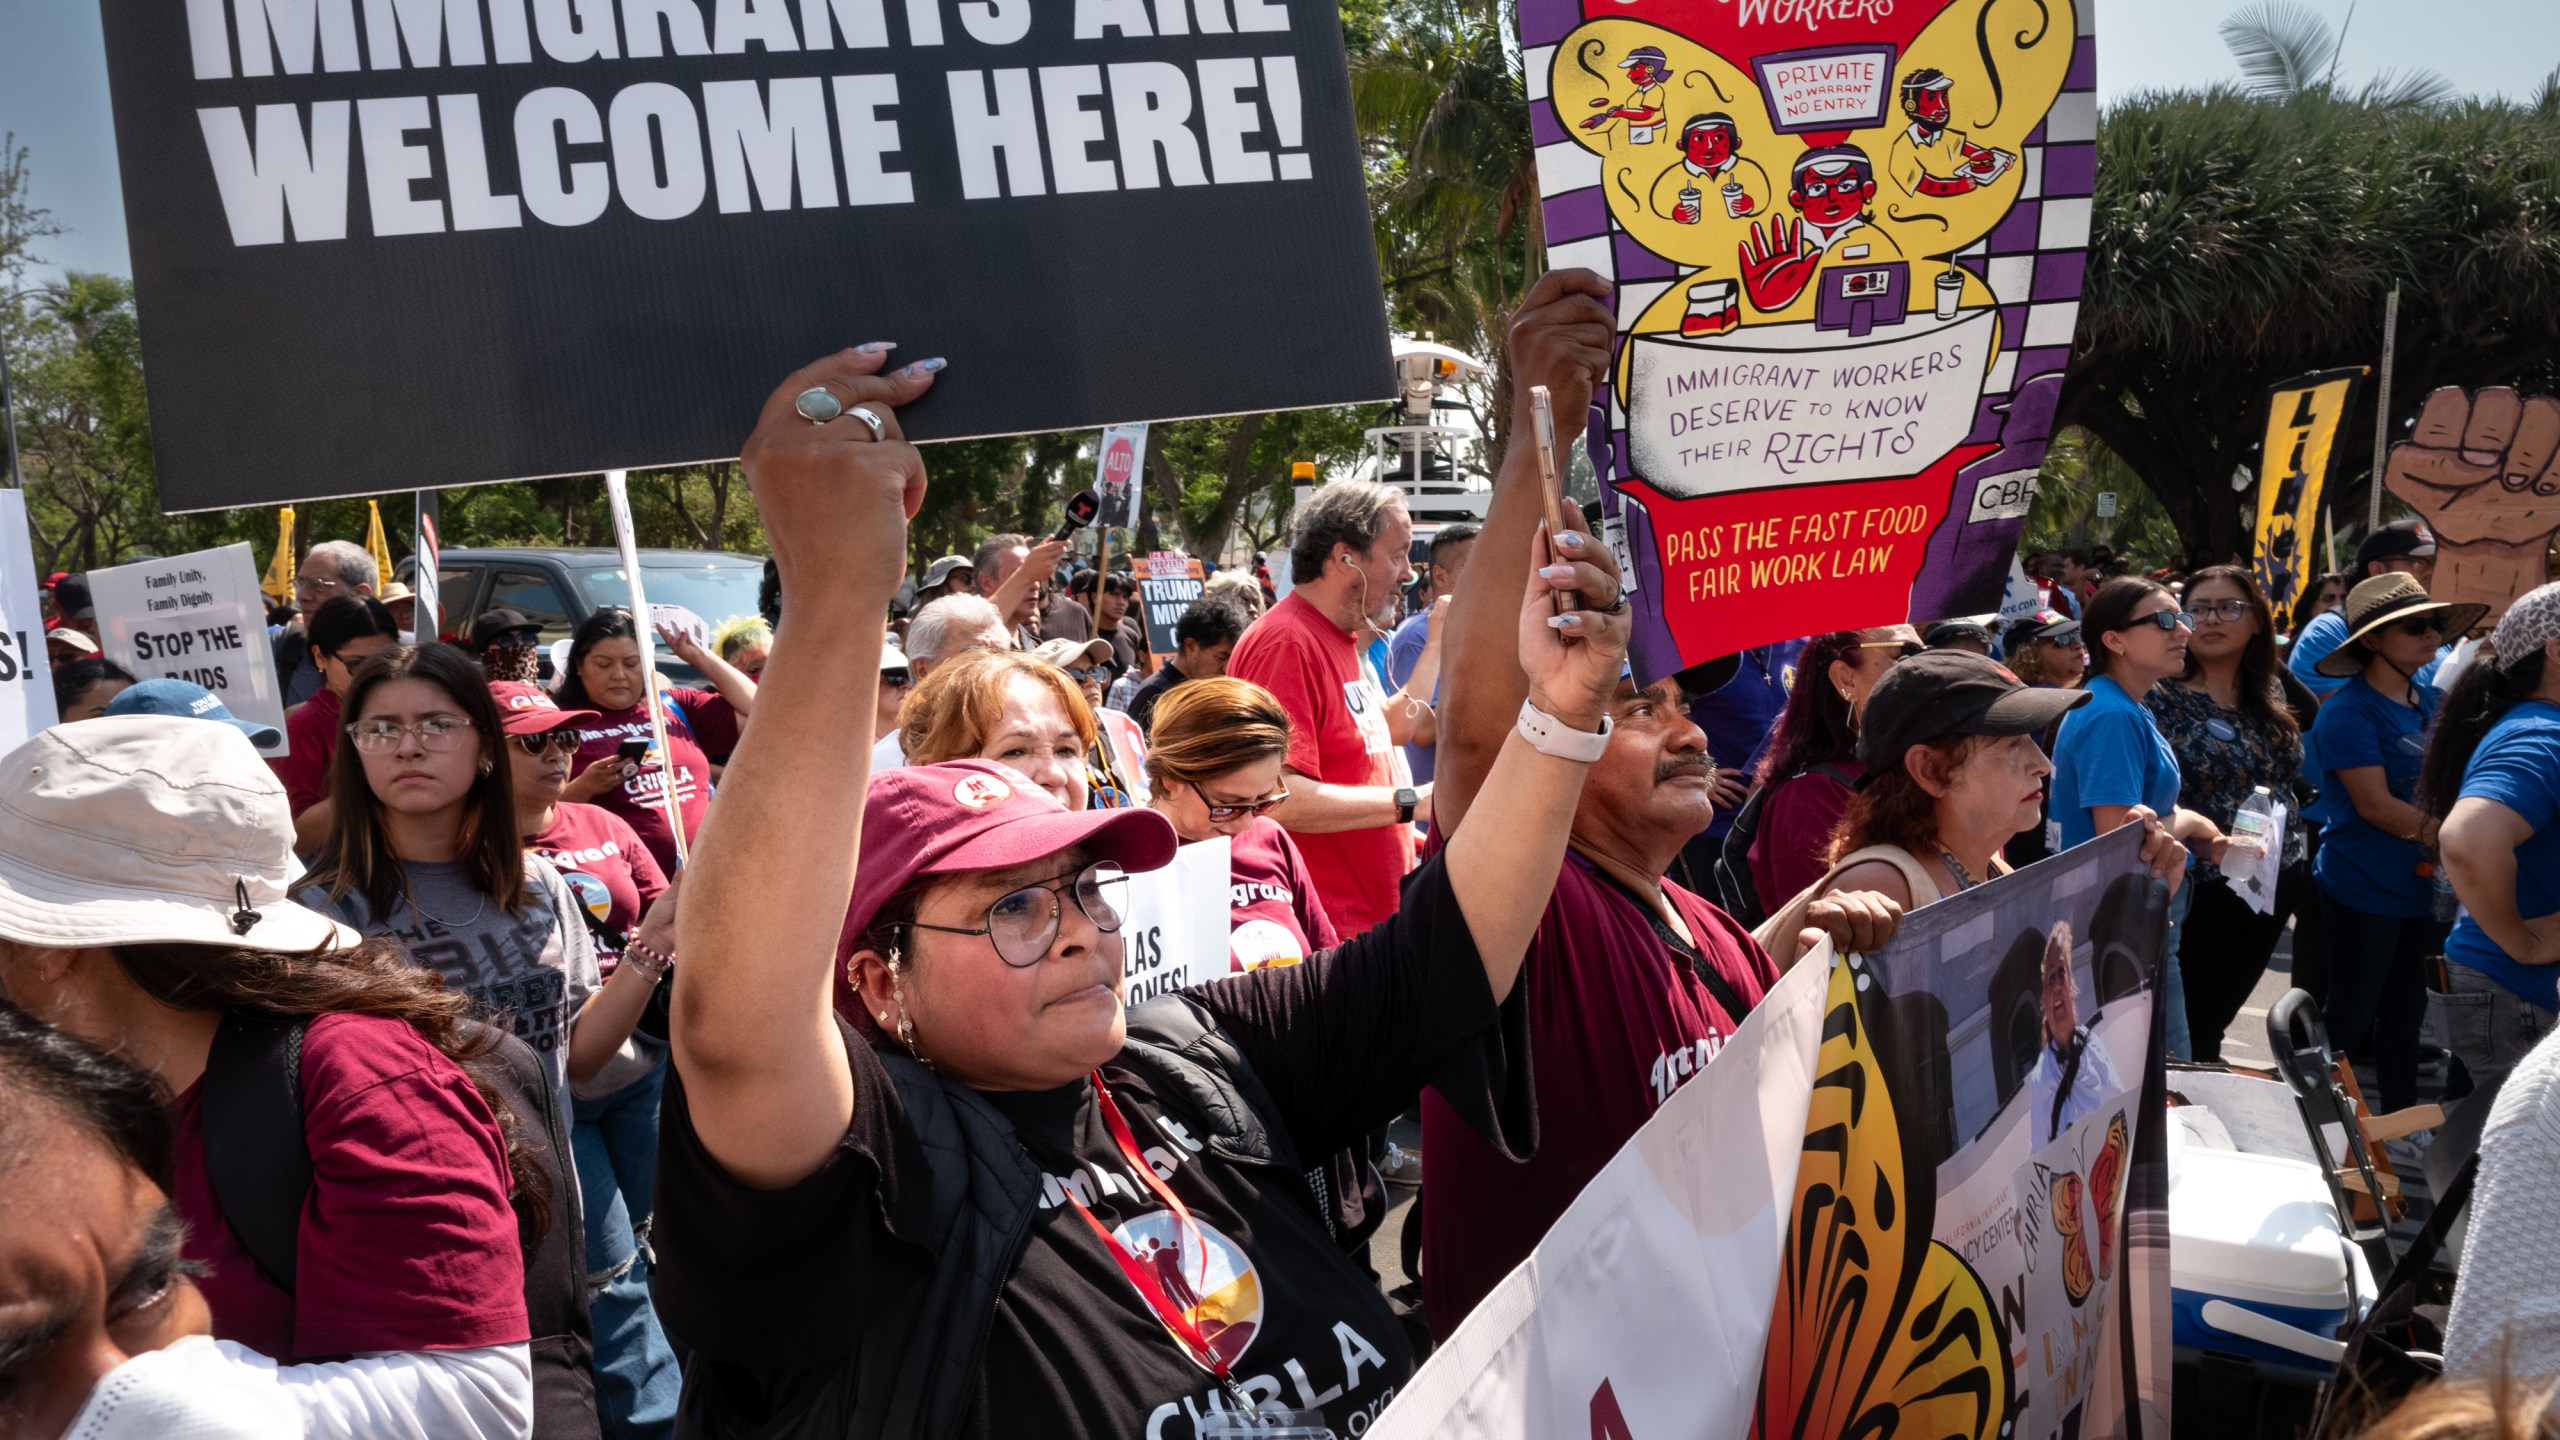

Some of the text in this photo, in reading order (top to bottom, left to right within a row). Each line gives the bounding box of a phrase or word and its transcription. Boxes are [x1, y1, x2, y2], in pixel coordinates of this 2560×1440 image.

[1737, 0, 1894, 31] WORKERS
[1776, 62, 1875, 90] PRIVATE
[1784, 84, 1872, 103] NO WARRANT
[1787, 98, 1867, 117] NO ENTRY
[196, 56, 1313, 247] WELCOME HERE!
[1666, 344, 1962, 398] IMMIGRANT WORKERS
[1670, 391, 1928, 437] DESERVE TO KNOW
[1106, 451, 1132, 473] ALTO
[1678, 421, 1919, 475] THEIR RIGHTS
[1666, 525, 1723, 567] PASS
[1731, 517, 1783, 555] THE
[1789, 510, 1858, 546] FAST
[1862, 504, 1928, 539] FOOD
[145, 568, 207, 589] Family Unity,
[1688, 544, 1895, 603] FAIR WORK LAW
[147, 590, 213, 612] Family Dignity
[1140, 579, 1203, 602] TRUMP
[1151, 602, 1191, 626] MUS
[134, 624, 243, 661] STOP THE
[165, 665, 228, 691] AIDS
[1983, 1207, 2015, 1253] CENTER
[2024, 1161, 2050, 1275] CHIRLA
